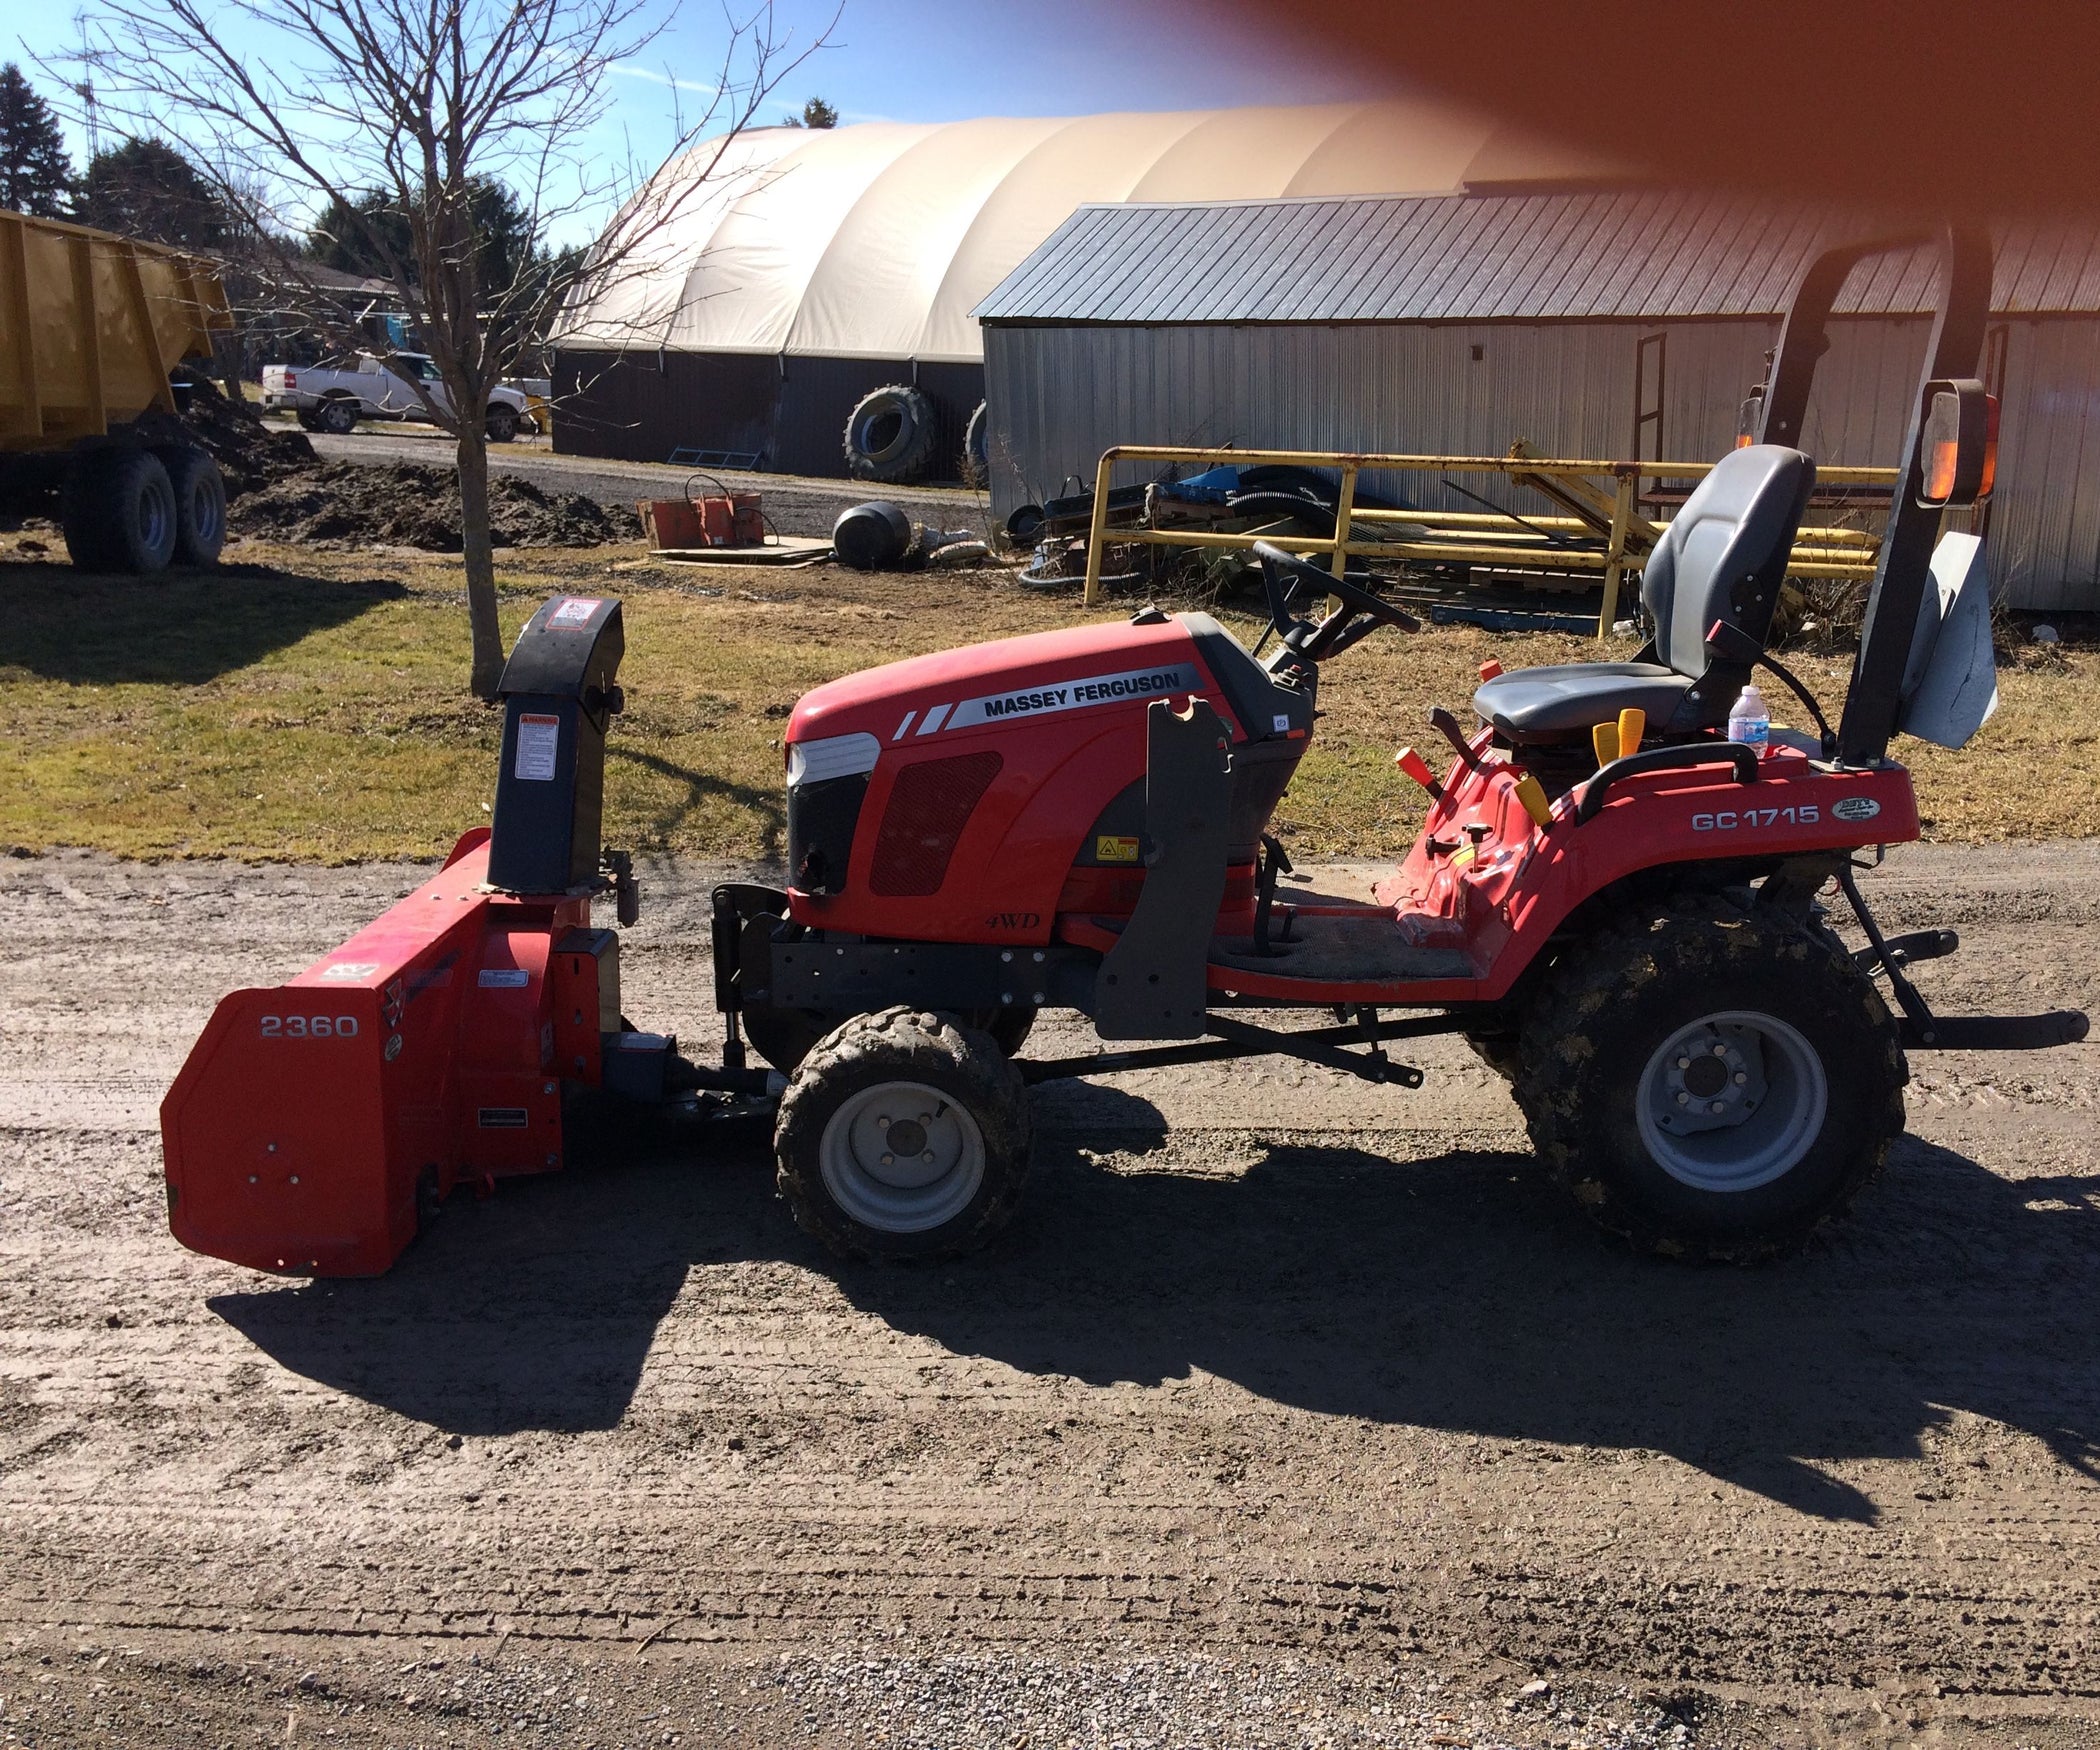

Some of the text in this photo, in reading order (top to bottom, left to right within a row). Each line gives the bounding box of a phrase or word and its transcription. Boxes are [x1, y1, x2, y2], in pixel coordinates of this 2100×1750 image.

[984, 672, 1181, 717] MASSEY FERGUSON
[985, 913, 1041, 929] 4WD
[260, 1015, 360, 1038] 2360
